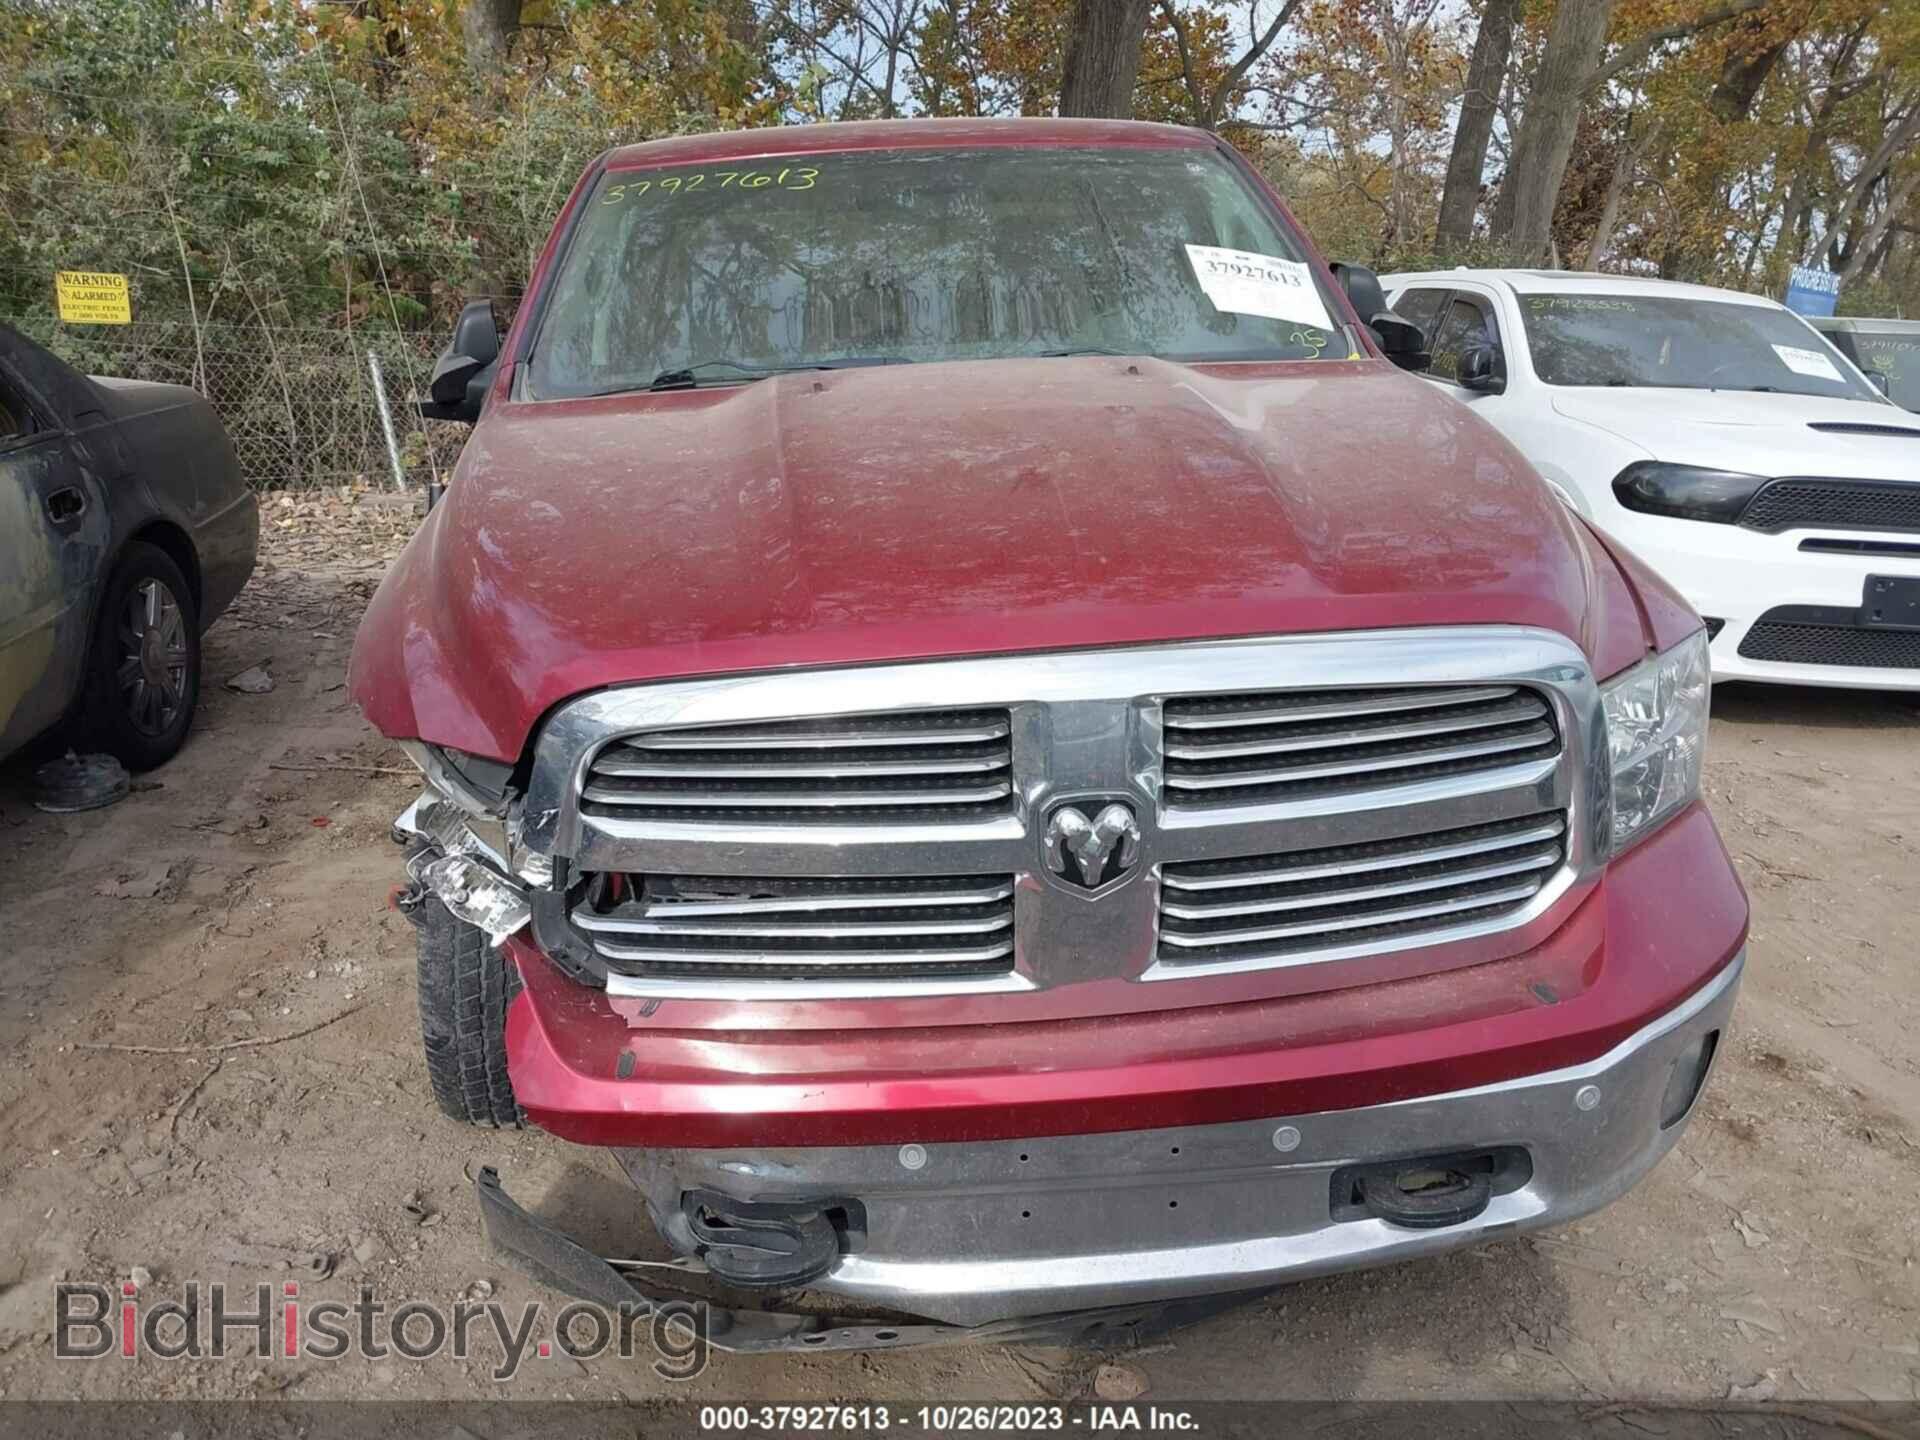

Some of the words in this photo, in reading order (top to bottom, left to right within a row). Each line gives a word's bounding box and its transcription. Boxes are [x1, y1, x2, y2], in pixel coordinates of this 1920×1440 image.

[602, 168, 819, 205] 37927613
[62, 273, 122, 287] WARNING
[1205, 260, 1302, 287] 37927613
[71, 290, 117, 301] ALARMED
